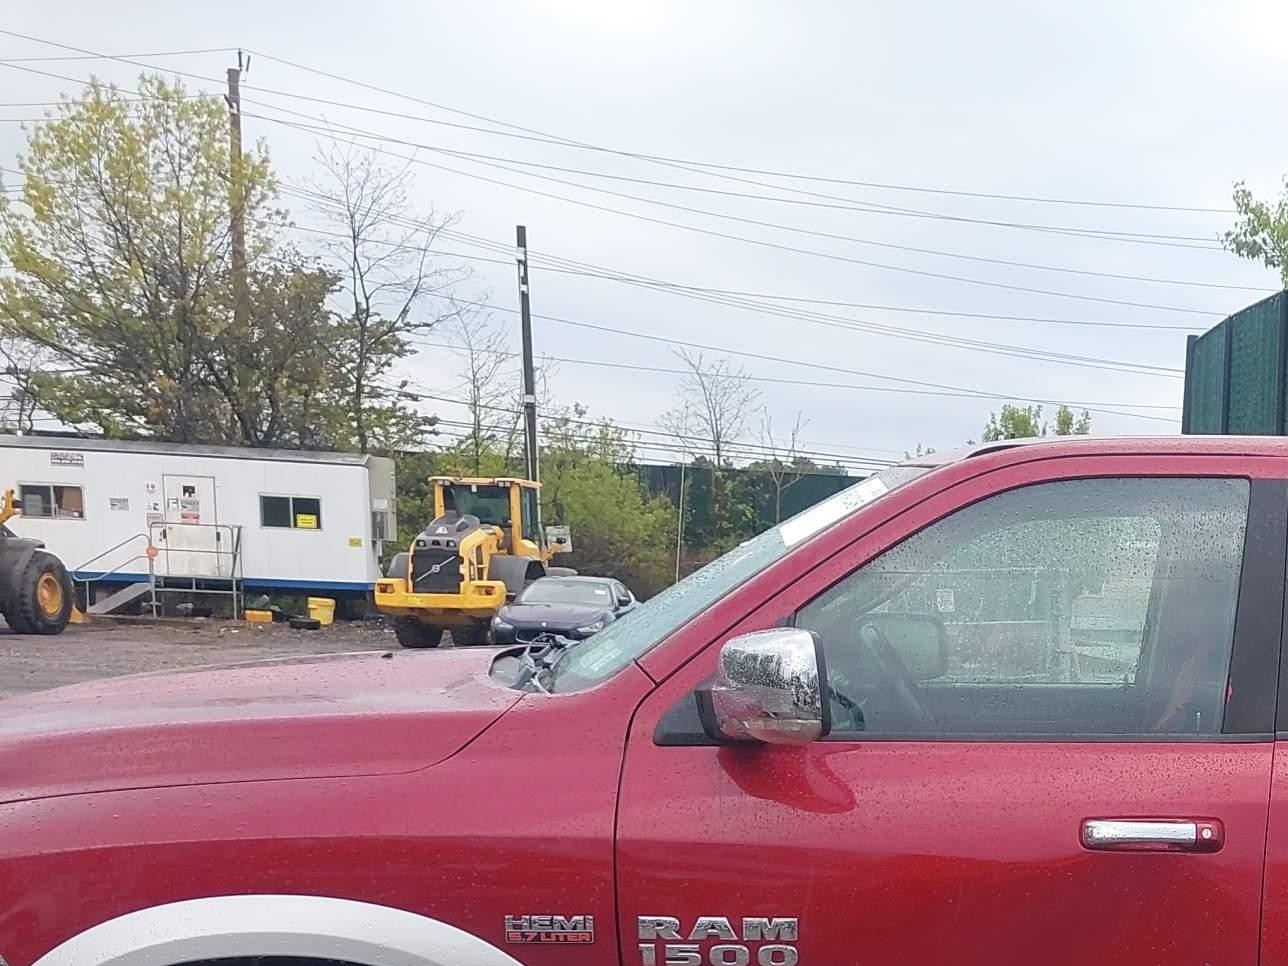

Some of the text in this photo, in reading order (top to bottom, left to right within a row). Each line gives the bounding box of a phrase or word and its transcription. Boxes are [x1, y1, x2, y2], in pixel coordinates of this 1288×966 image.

[505, 915, 594, 931] HEMI
[637, 915, 799, 941] RAM
[541, 932, 591, 942] LITER
